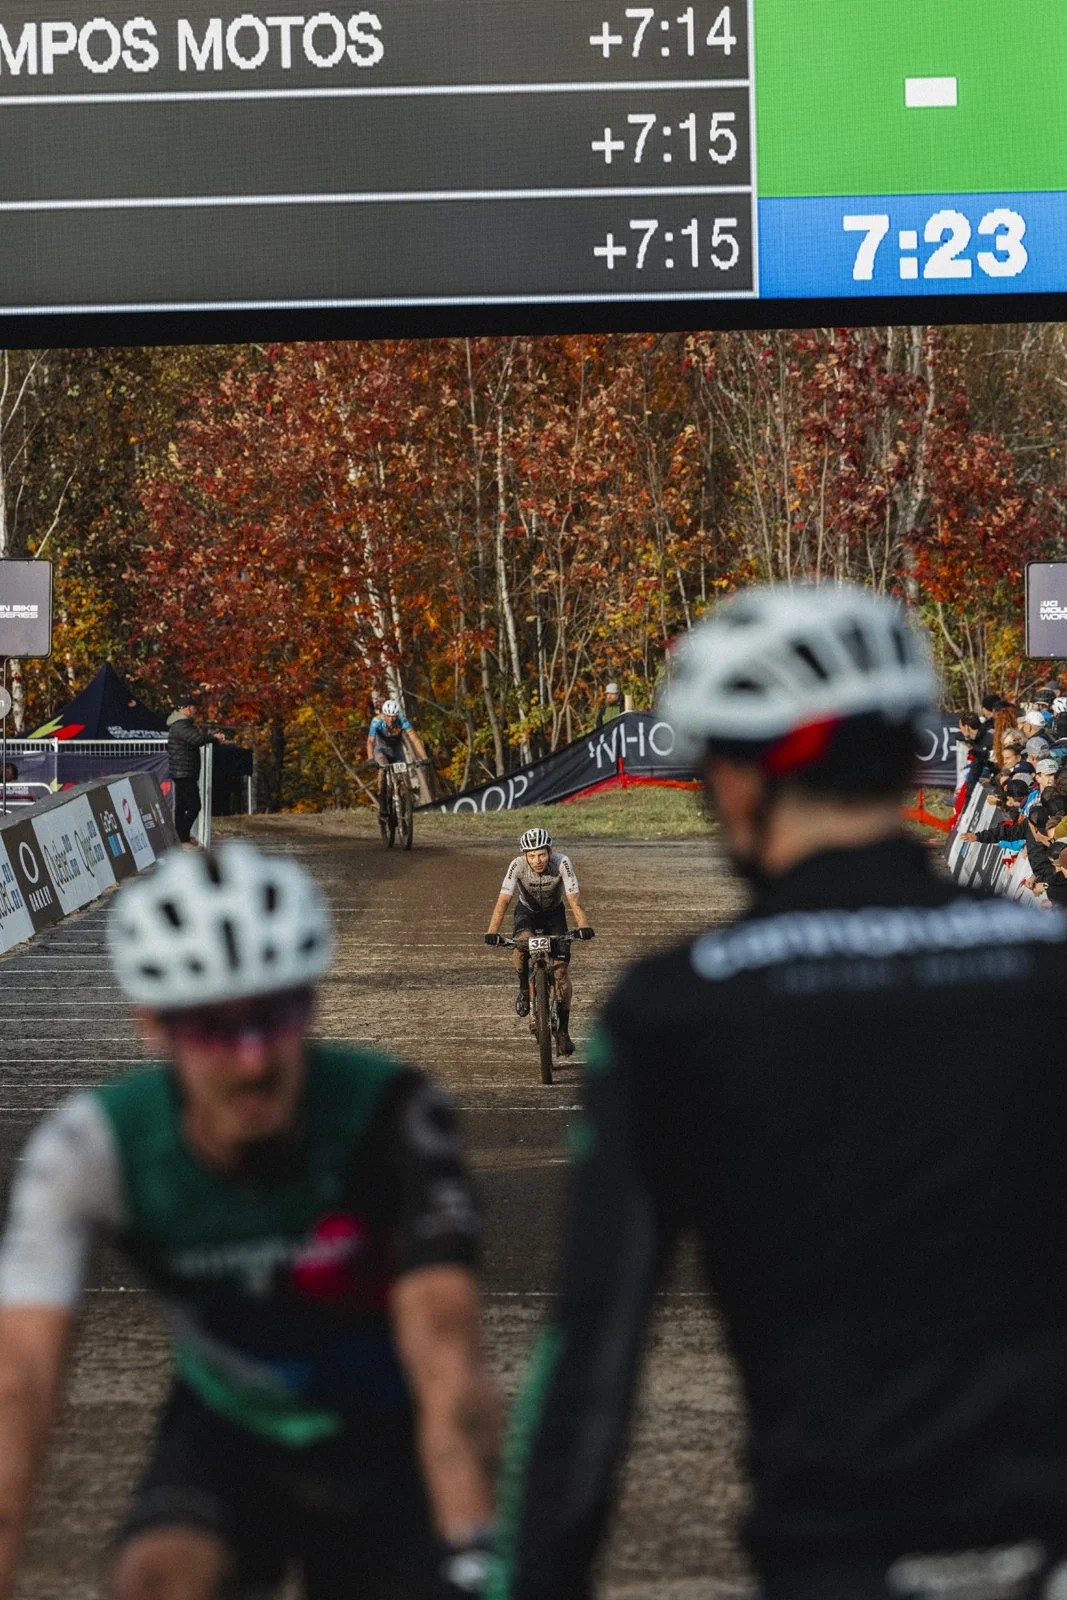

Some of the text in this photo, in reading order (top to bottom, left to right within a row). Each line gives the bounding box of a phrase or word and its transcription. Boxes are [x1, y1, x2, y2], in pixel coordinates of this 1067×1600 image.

[0, 11, 384, 75] MPOS MOTOS
[589, 6, 737, 58] +7:14
[591, 111, 738, 164] +7:15
[593, 217, 740, 271] +7:15
[842, 208, 1029, 281] 7:23
